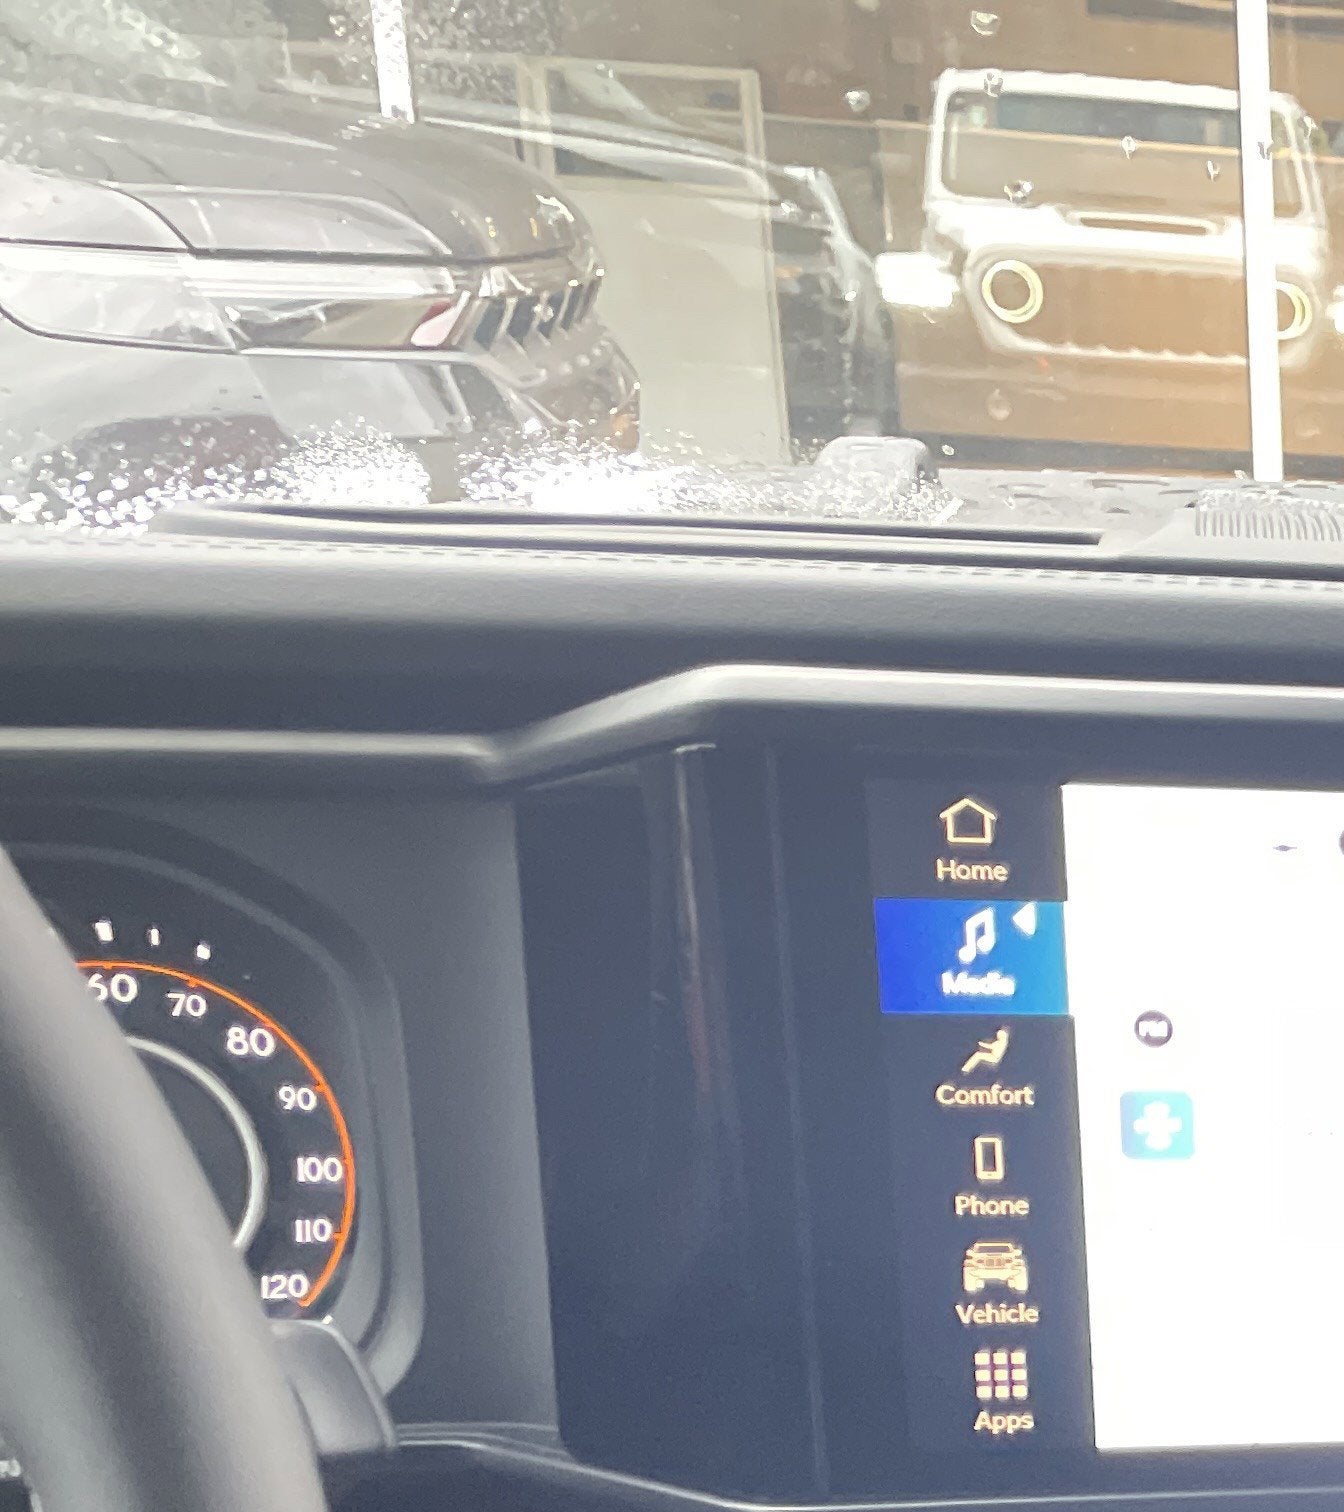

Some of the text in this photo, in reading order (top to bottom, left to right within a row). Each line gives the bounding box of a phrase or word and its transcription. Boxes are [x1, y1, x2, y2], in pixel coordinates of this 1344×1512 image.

[936, 859, 1008, 881] Home
[941, 971, 1015, 997] Media
[166, 991, 207, 1018] 70
[226, 1026, 275, 1057] 80
[277, 1086, 317, 1111] 90
[936, 1083, 1035, 1106] Comfort
[297, 1157, 342, 1183] 100
[954, 1195, 1030, 1216] Phone
[295, 1219, 332, 1243] 110
[260, 1274, 309, 1300] 120
[955, 1303, 1040, 1325] Vehicle
[974, 1410, 1035, 1434] Apps
